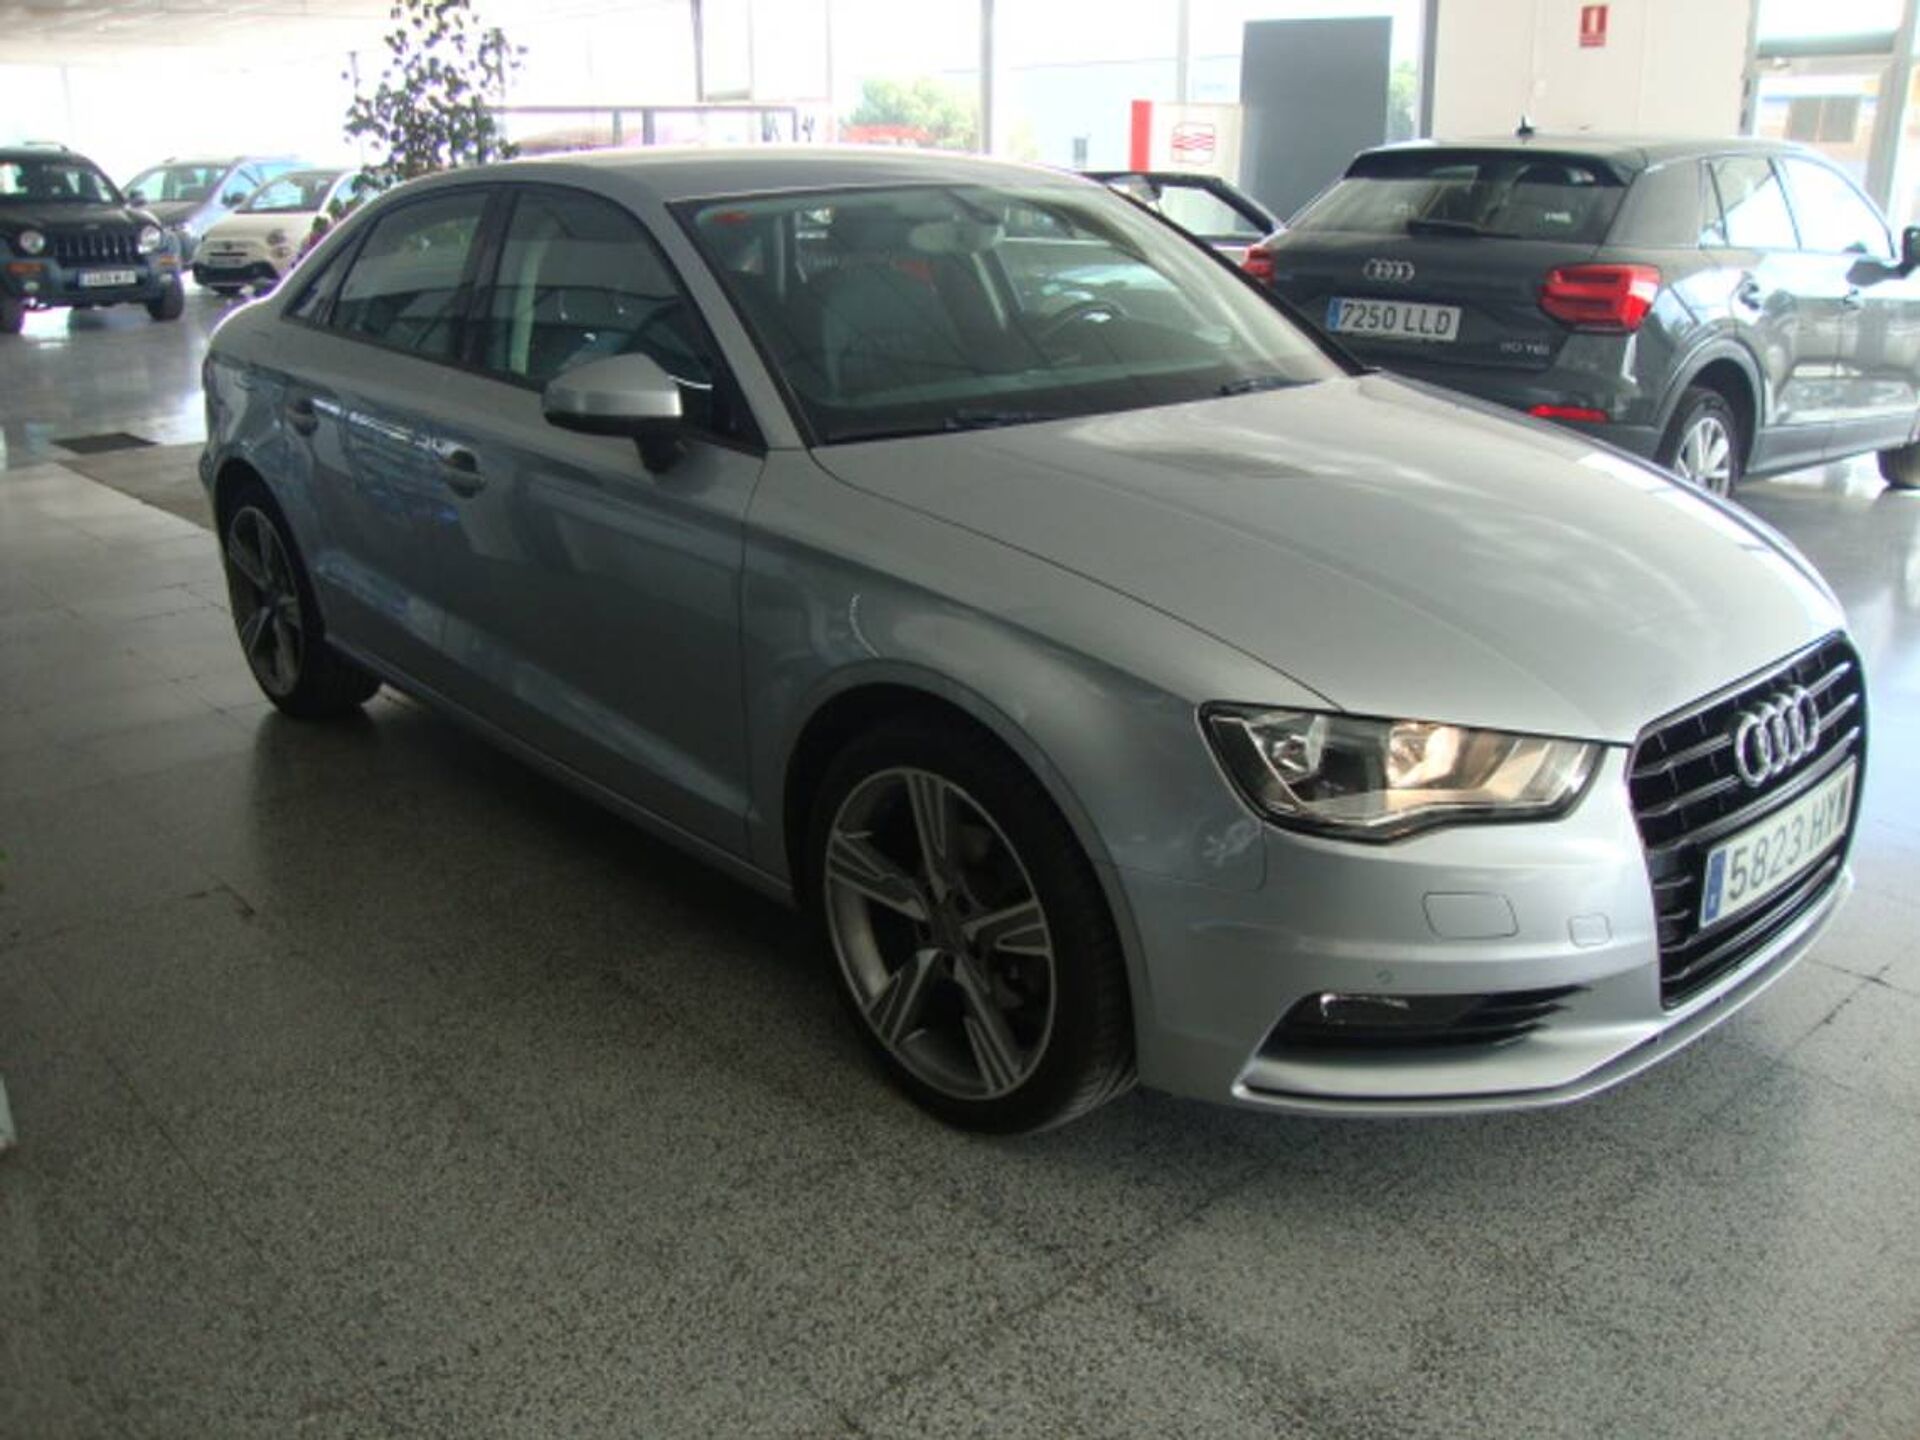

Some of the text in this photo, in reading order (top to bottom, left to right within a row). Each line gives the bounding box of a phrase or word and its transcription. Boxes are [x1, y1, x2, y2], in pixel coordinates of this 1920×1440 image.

[1341, 303, 1451, 335] 7250 LLD
[1728, 815, 1806, 900] 5823
